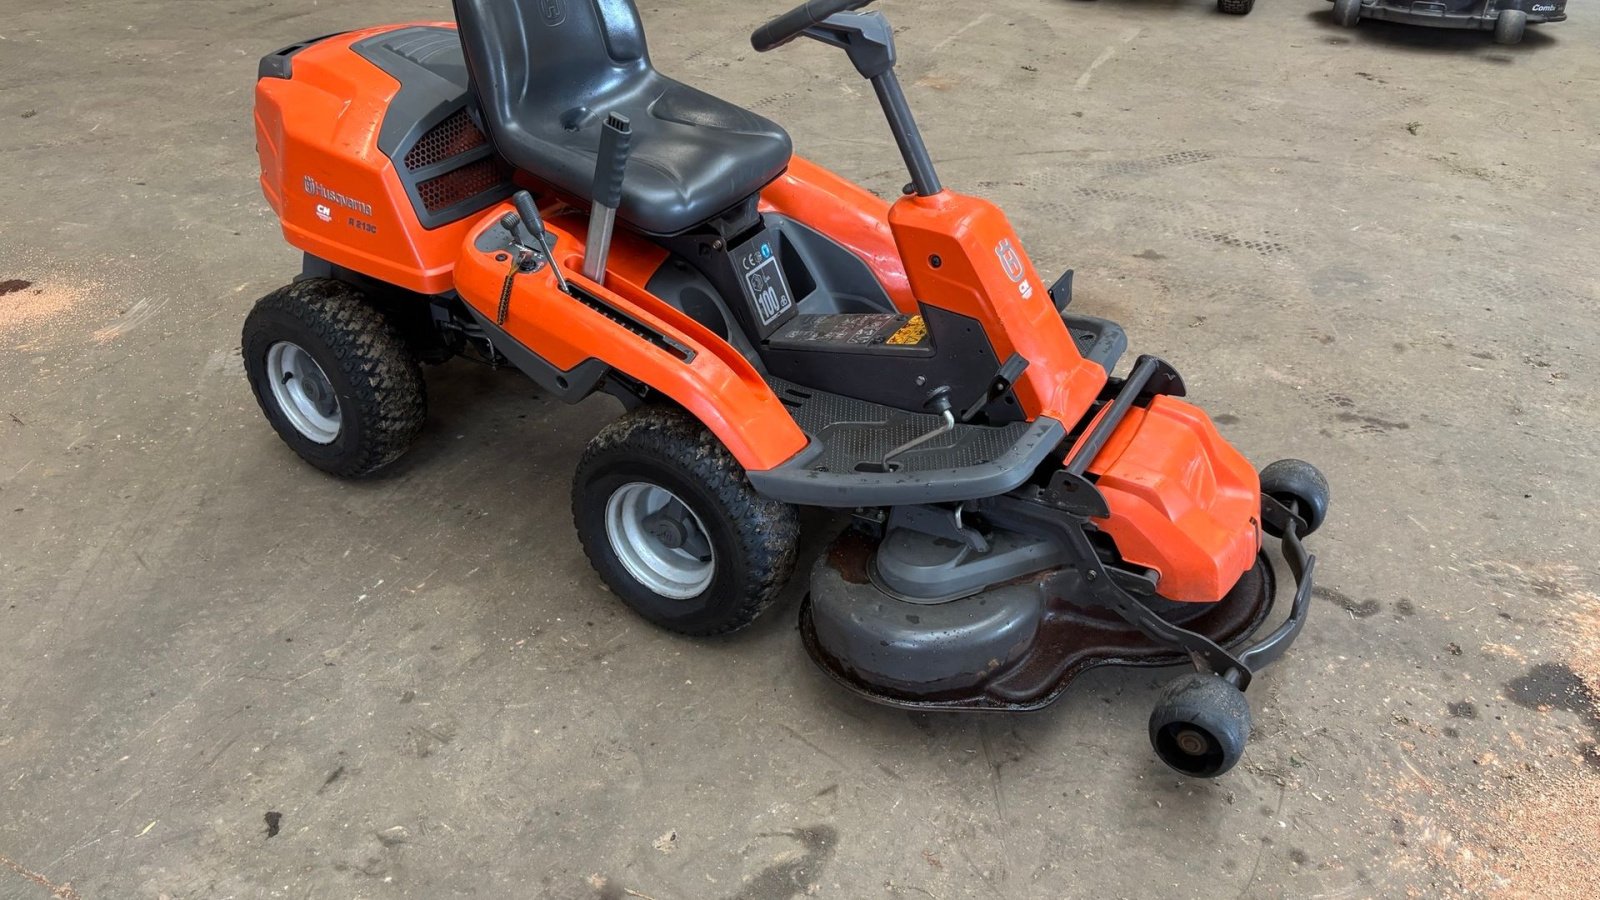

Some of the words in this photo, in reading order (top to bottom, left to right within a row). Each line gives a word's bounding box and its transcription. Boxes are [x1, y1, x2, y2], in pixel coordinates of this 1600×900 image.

[315, 182, 372, 216] Husqvarna
[348, 217, 355, 227] R
[356, 220, 377, 233] 213C
[758, 286, 780, 318] 100
